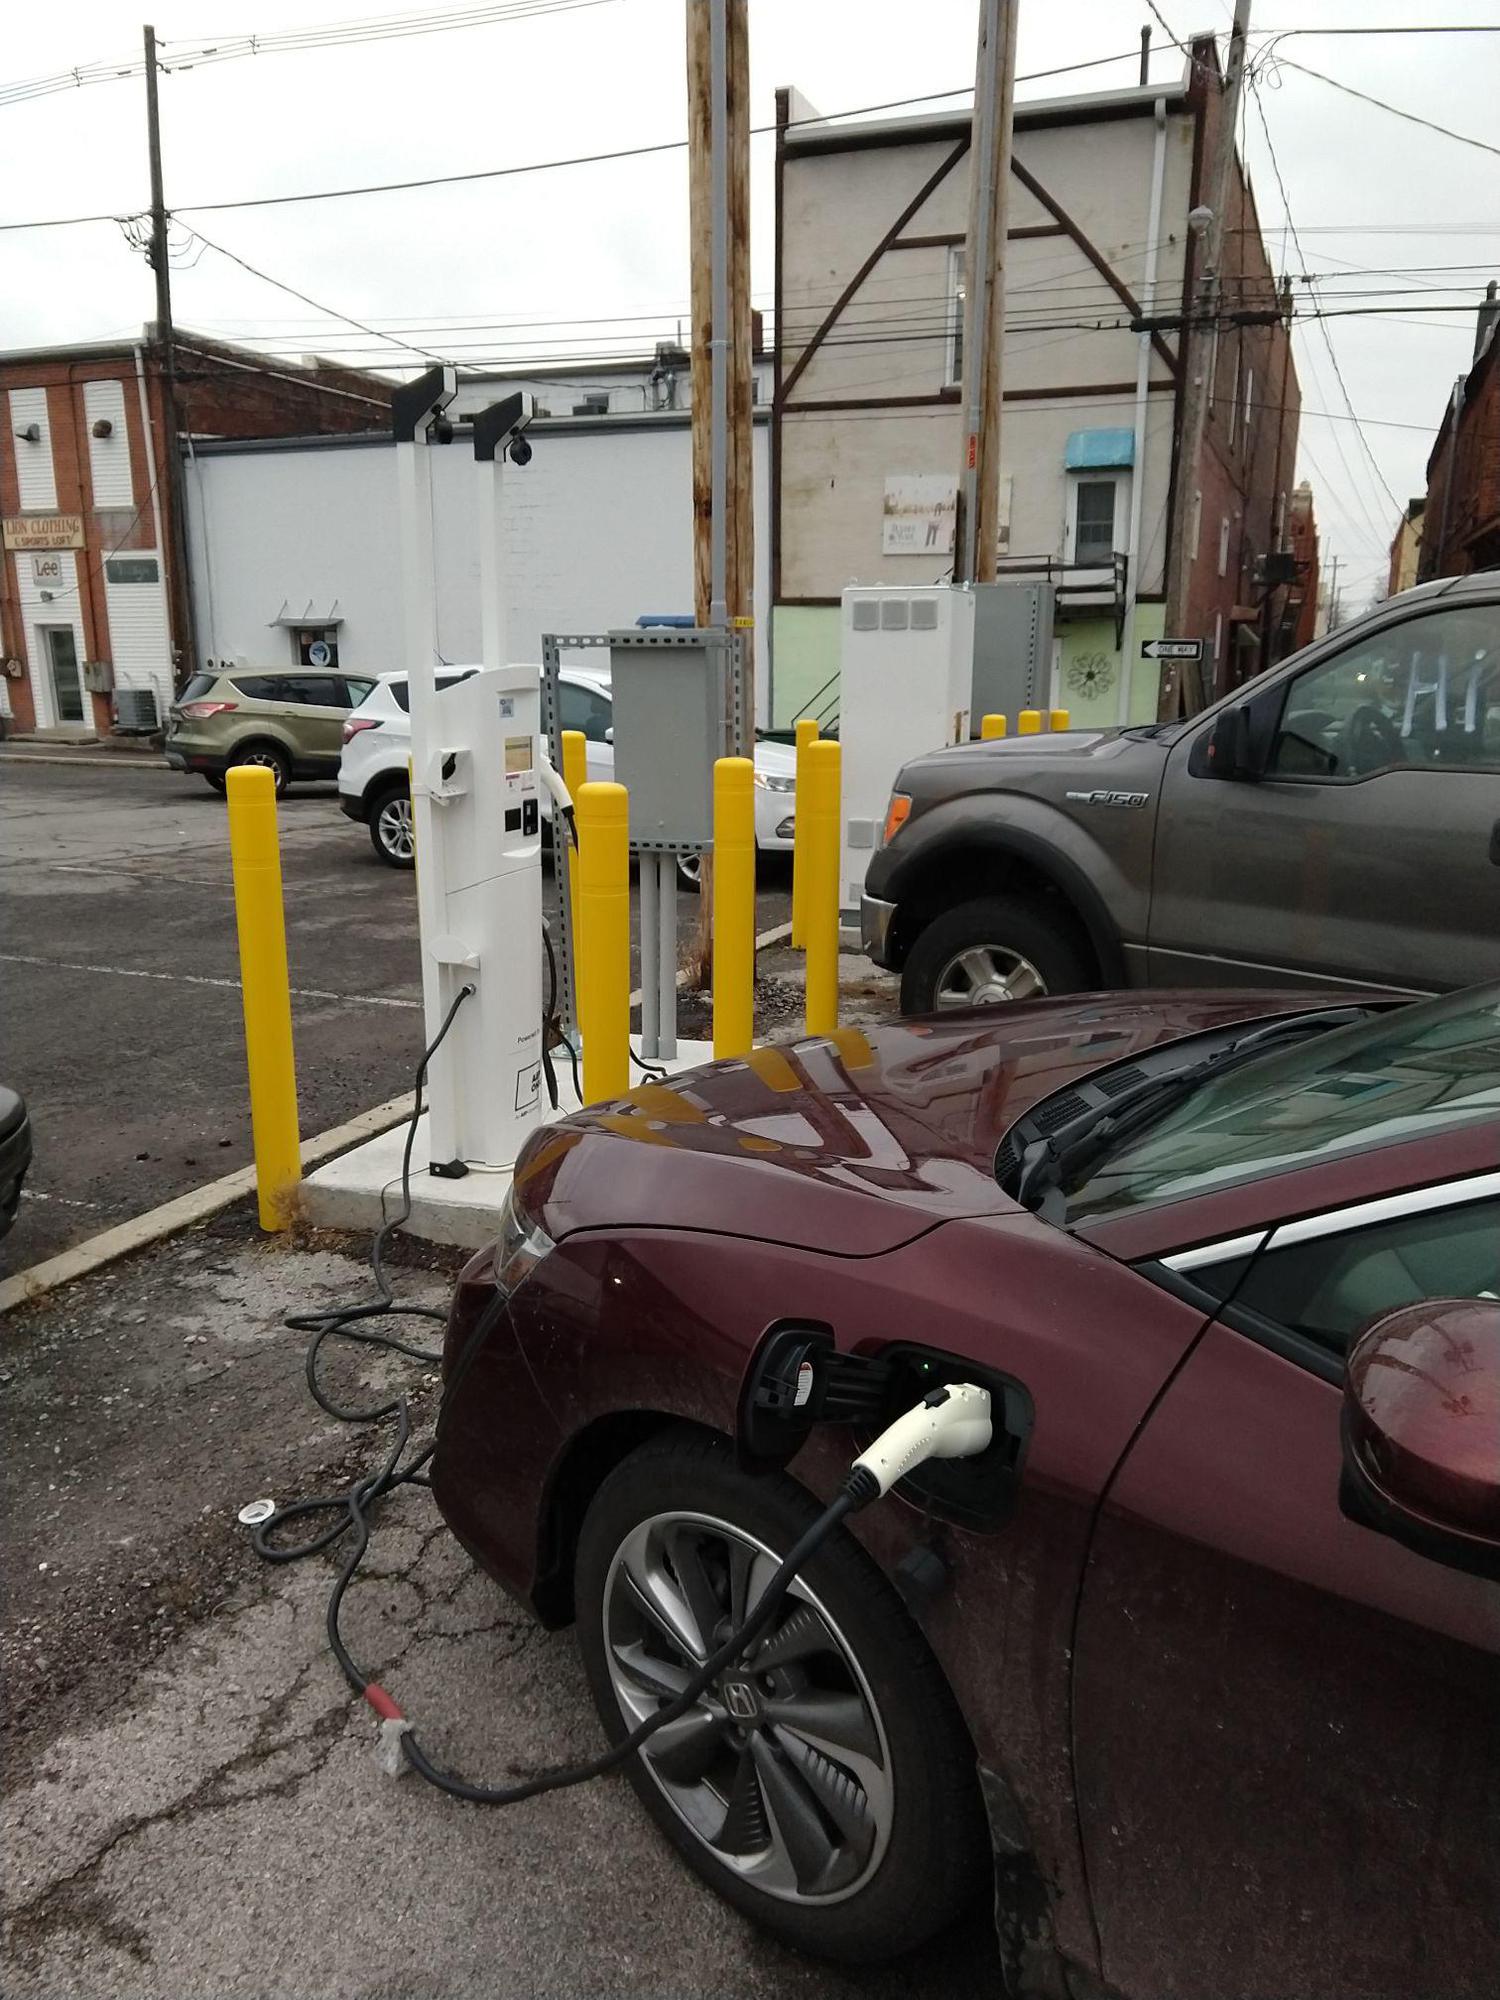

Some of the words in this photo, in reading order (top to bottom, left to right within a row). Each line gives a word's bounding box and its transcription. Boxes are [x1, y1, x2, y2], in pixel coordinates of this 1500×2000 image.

[6, 519, 28, 535] LION
[31, 517, 80, 533] CLOTHING
[35, 559, 58, 576] Lee
[1159, 645, 1174, 653] ONE
[1177, 645, 1195, 653] WAY
